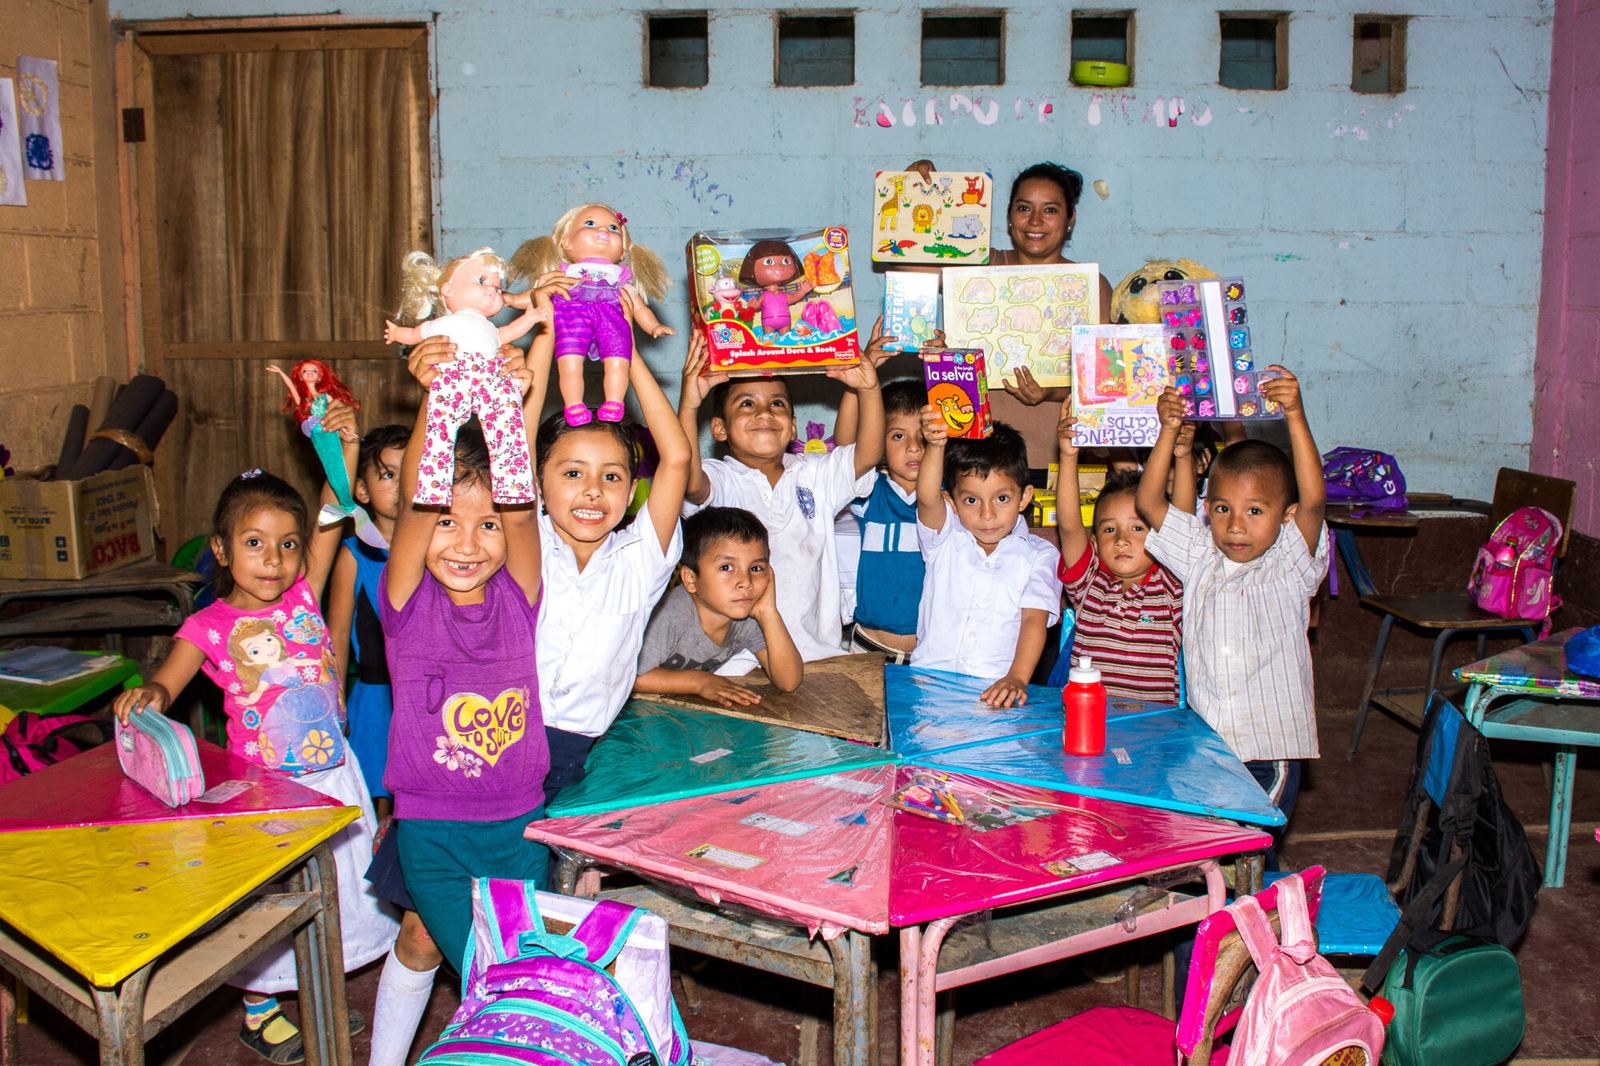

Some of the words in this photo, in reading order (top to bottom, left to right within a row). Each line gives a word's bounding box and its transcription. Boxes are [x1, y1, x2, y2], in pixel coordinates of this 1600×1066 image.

[730, 349, 755, 359] Splash
[757, 347, 785, 357] Around
[787, 347, 806, 355] Dora
[815, 345, 836, 353] Boots
[927, 365, 940, 381] la
[942, 366, 974, 381] selva
